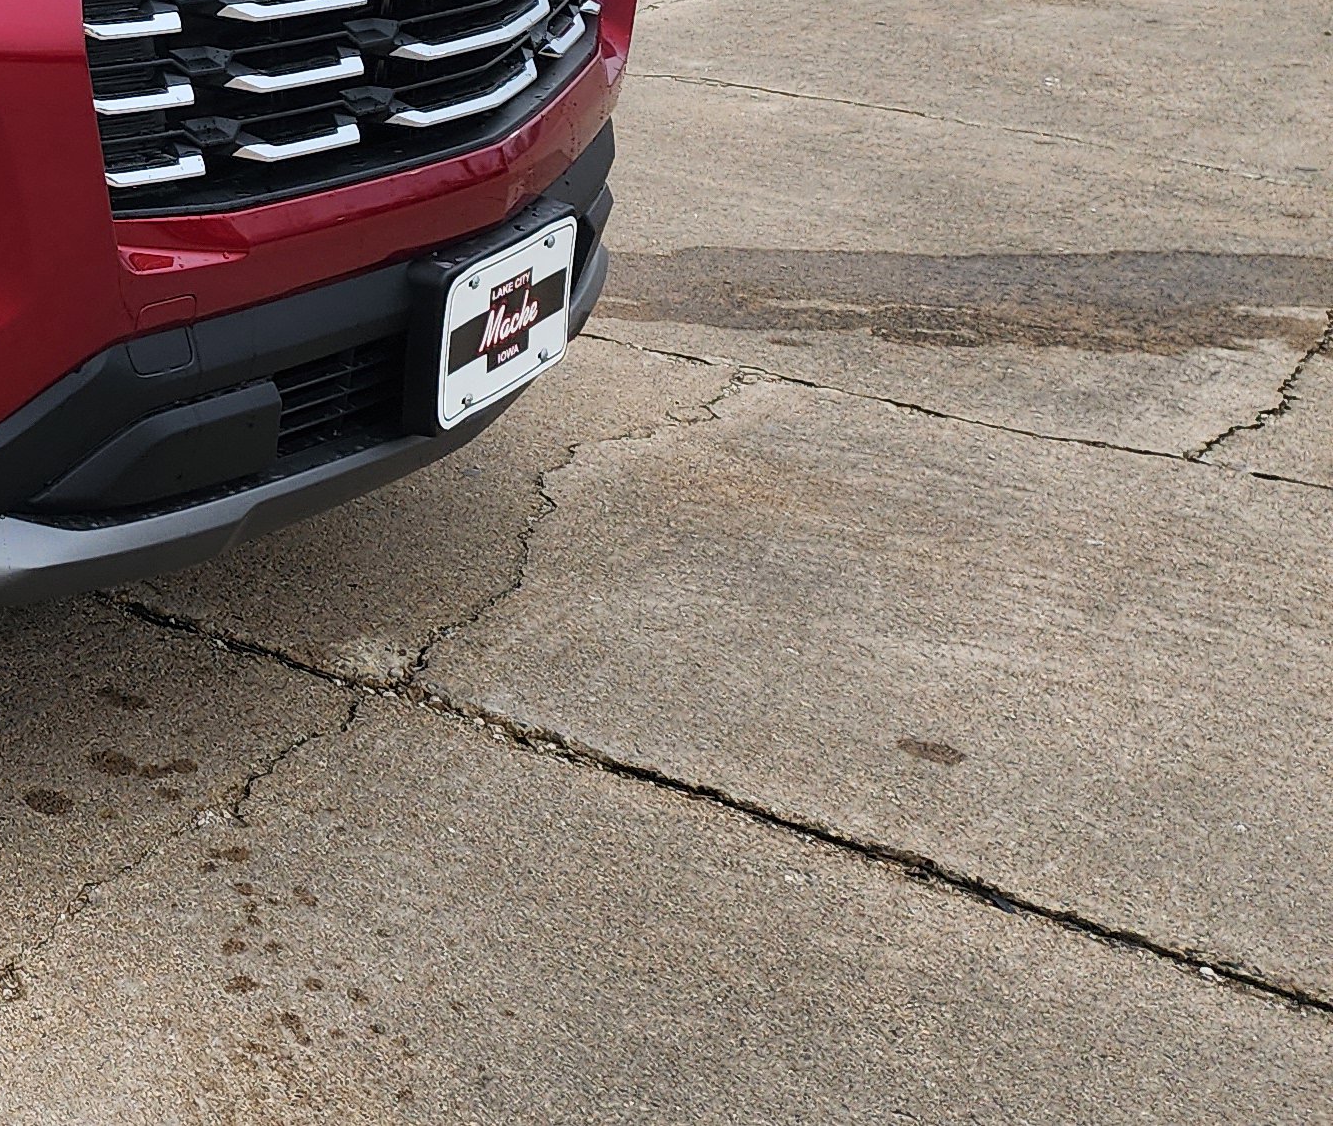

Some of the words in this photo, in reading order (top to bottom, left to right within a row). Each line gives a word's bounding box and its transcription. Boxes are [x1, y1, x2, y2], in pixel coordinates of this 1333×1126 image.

[491, 279, 514, 301] LAKE
[514, 271, 531, 287] CITY
[478, 288, 539, 354] Macke
[497, 343, 520, 364] IOWA
